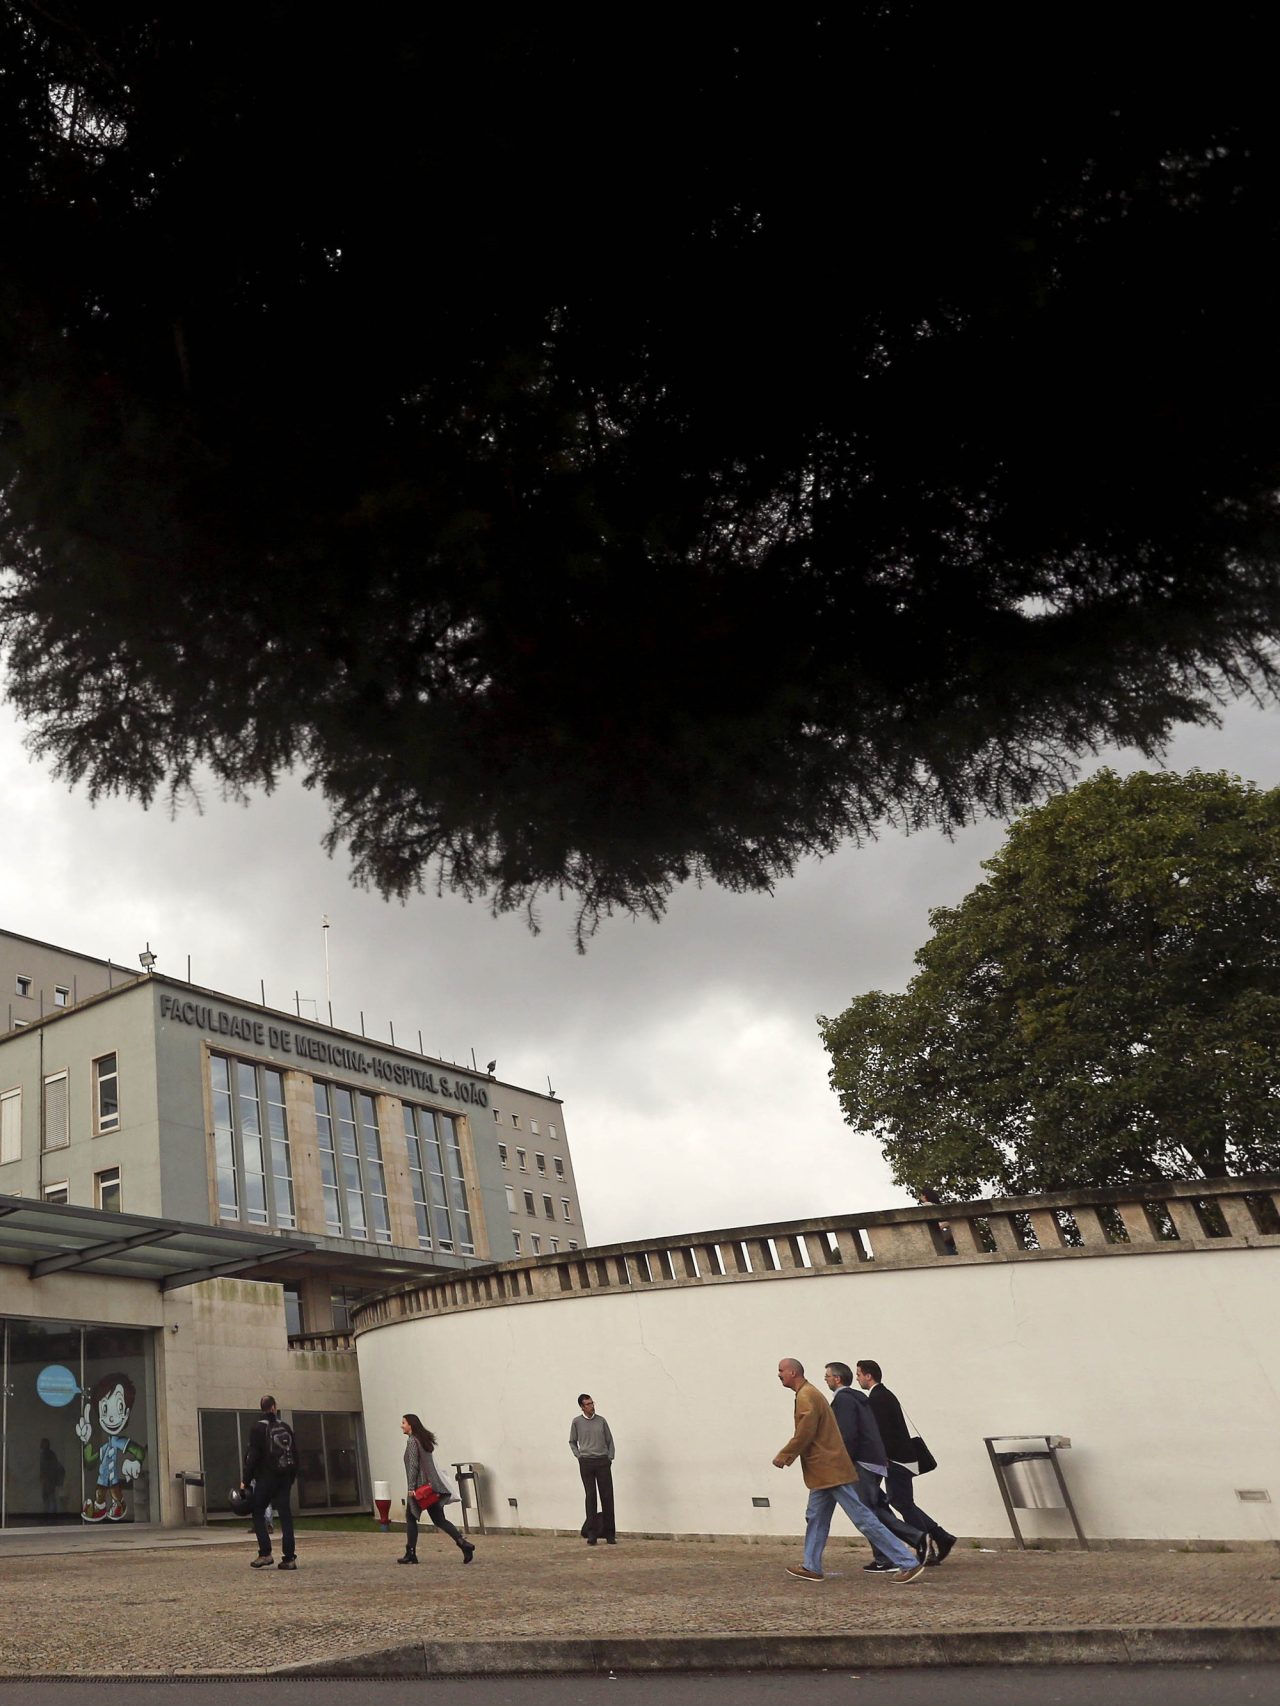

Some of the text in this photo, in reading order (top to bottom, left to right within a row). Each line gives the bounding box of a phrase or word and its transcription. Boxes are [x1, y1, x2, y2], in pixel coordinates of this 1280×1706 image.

[160, 994, 265, 1045] FACULDADE
[269, 1026, 292, 1052] DE
[439, 1077, 453, 1098] S.
[454, 1080, 488, 1107] JOÃO
